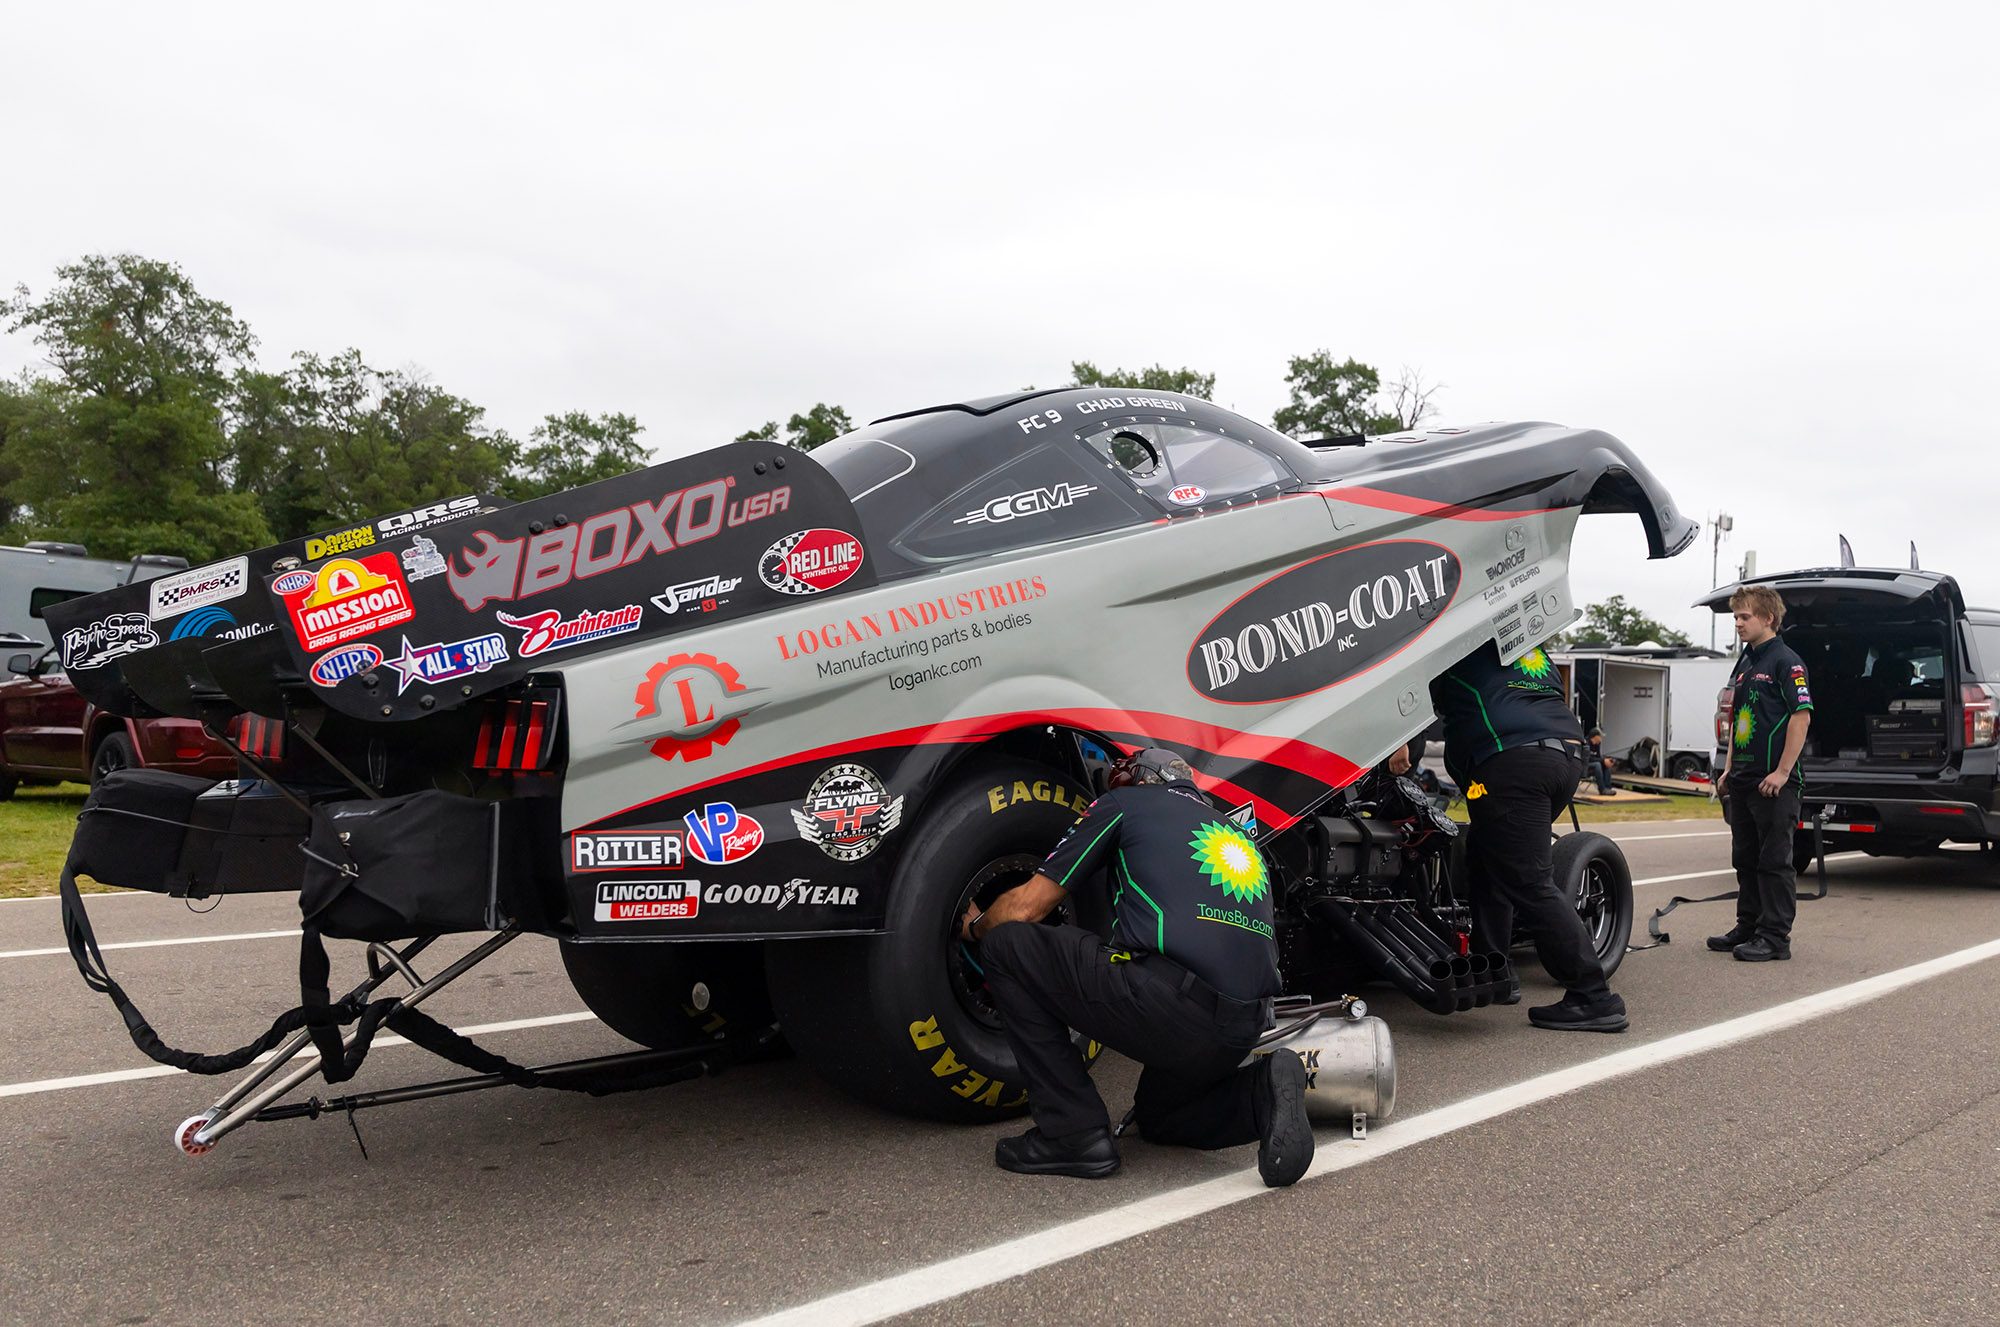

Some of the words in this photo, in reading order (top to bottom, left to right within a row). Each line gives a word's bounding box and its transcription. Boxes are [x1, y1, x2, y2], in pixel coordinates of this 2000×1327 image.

[1017, 413, 1047, 435] FC
[1044, 409, 1063, 425] 9
[1075, 397, 1126, 415] CHAD
[1129, 397, 1187, 413] GREEN
[983, 482, 1074, 523] CGM
[1174, 486, 1200, 501] RFC
[377, 495, 480, 532] QRS
[382, 523, 423, 539] RACING
[426, 507, 482, 527] PRODUCTS
[305, 525, 373, 561] DARTON
[326, 537, 376, 555] SLEEVES
[518, 478, 729, 599] BOXO
[727, 485, 791, 528] USA
[790, 548, 821, 574] RED
[824, 541, 858, 567] LINE
[802, 566, 837, 580] SYNTHETIC
[1486, 549, 1525, 580] MONROE
[180, 579, 220, 600] BMRS
[277, 573, 312, 591] NHRA
[650, 575, 743, 614] Sander
[305, 588, 401, 632] MISSION
[776, 613, 882, 660] LOGAN
[888, 575, 1048, 633] INDUSTRIES
[1200, 553, 1448, 691] BOND-COAT
[309, 635, 338, 649] DRAG
[339, 621, 377, 641] RACING
[378, 609, 413, 631] SERIES
[502, 604, 642, 656] Boninfante
[817, 637, 929, 678] Manufacturing
[932, 628, 968, 653] parts
[971, 623, 983, 639] &
[985, 611, 1032, 635] bodies
[1337, 633, 1358, 653] INC.
[1500, 632, 1525, 656] MOOG
[322, 650, 374, 679] NHRA
[427, 653, 458, 677] ALL
[463, 637, 503, 666] STAR
[889, 653, 982, 691] logankc.com
[675, 677, 715, 728] L
[814, 792, 879, 811] FLYING
[987, 780, 1089, 815] EAGLE
[684, 802, 738, 862] VP
[725, 829, 761, 856] Racing
[825, 830, 848, 839] DRAG
[575, 836, 682, 866] ROTTLER
[602, 884, 682, 901] LINCOLN
[619, 903, 688, 918] WELDERS
[1197, 903, 1274, 937] TonysBp.com
